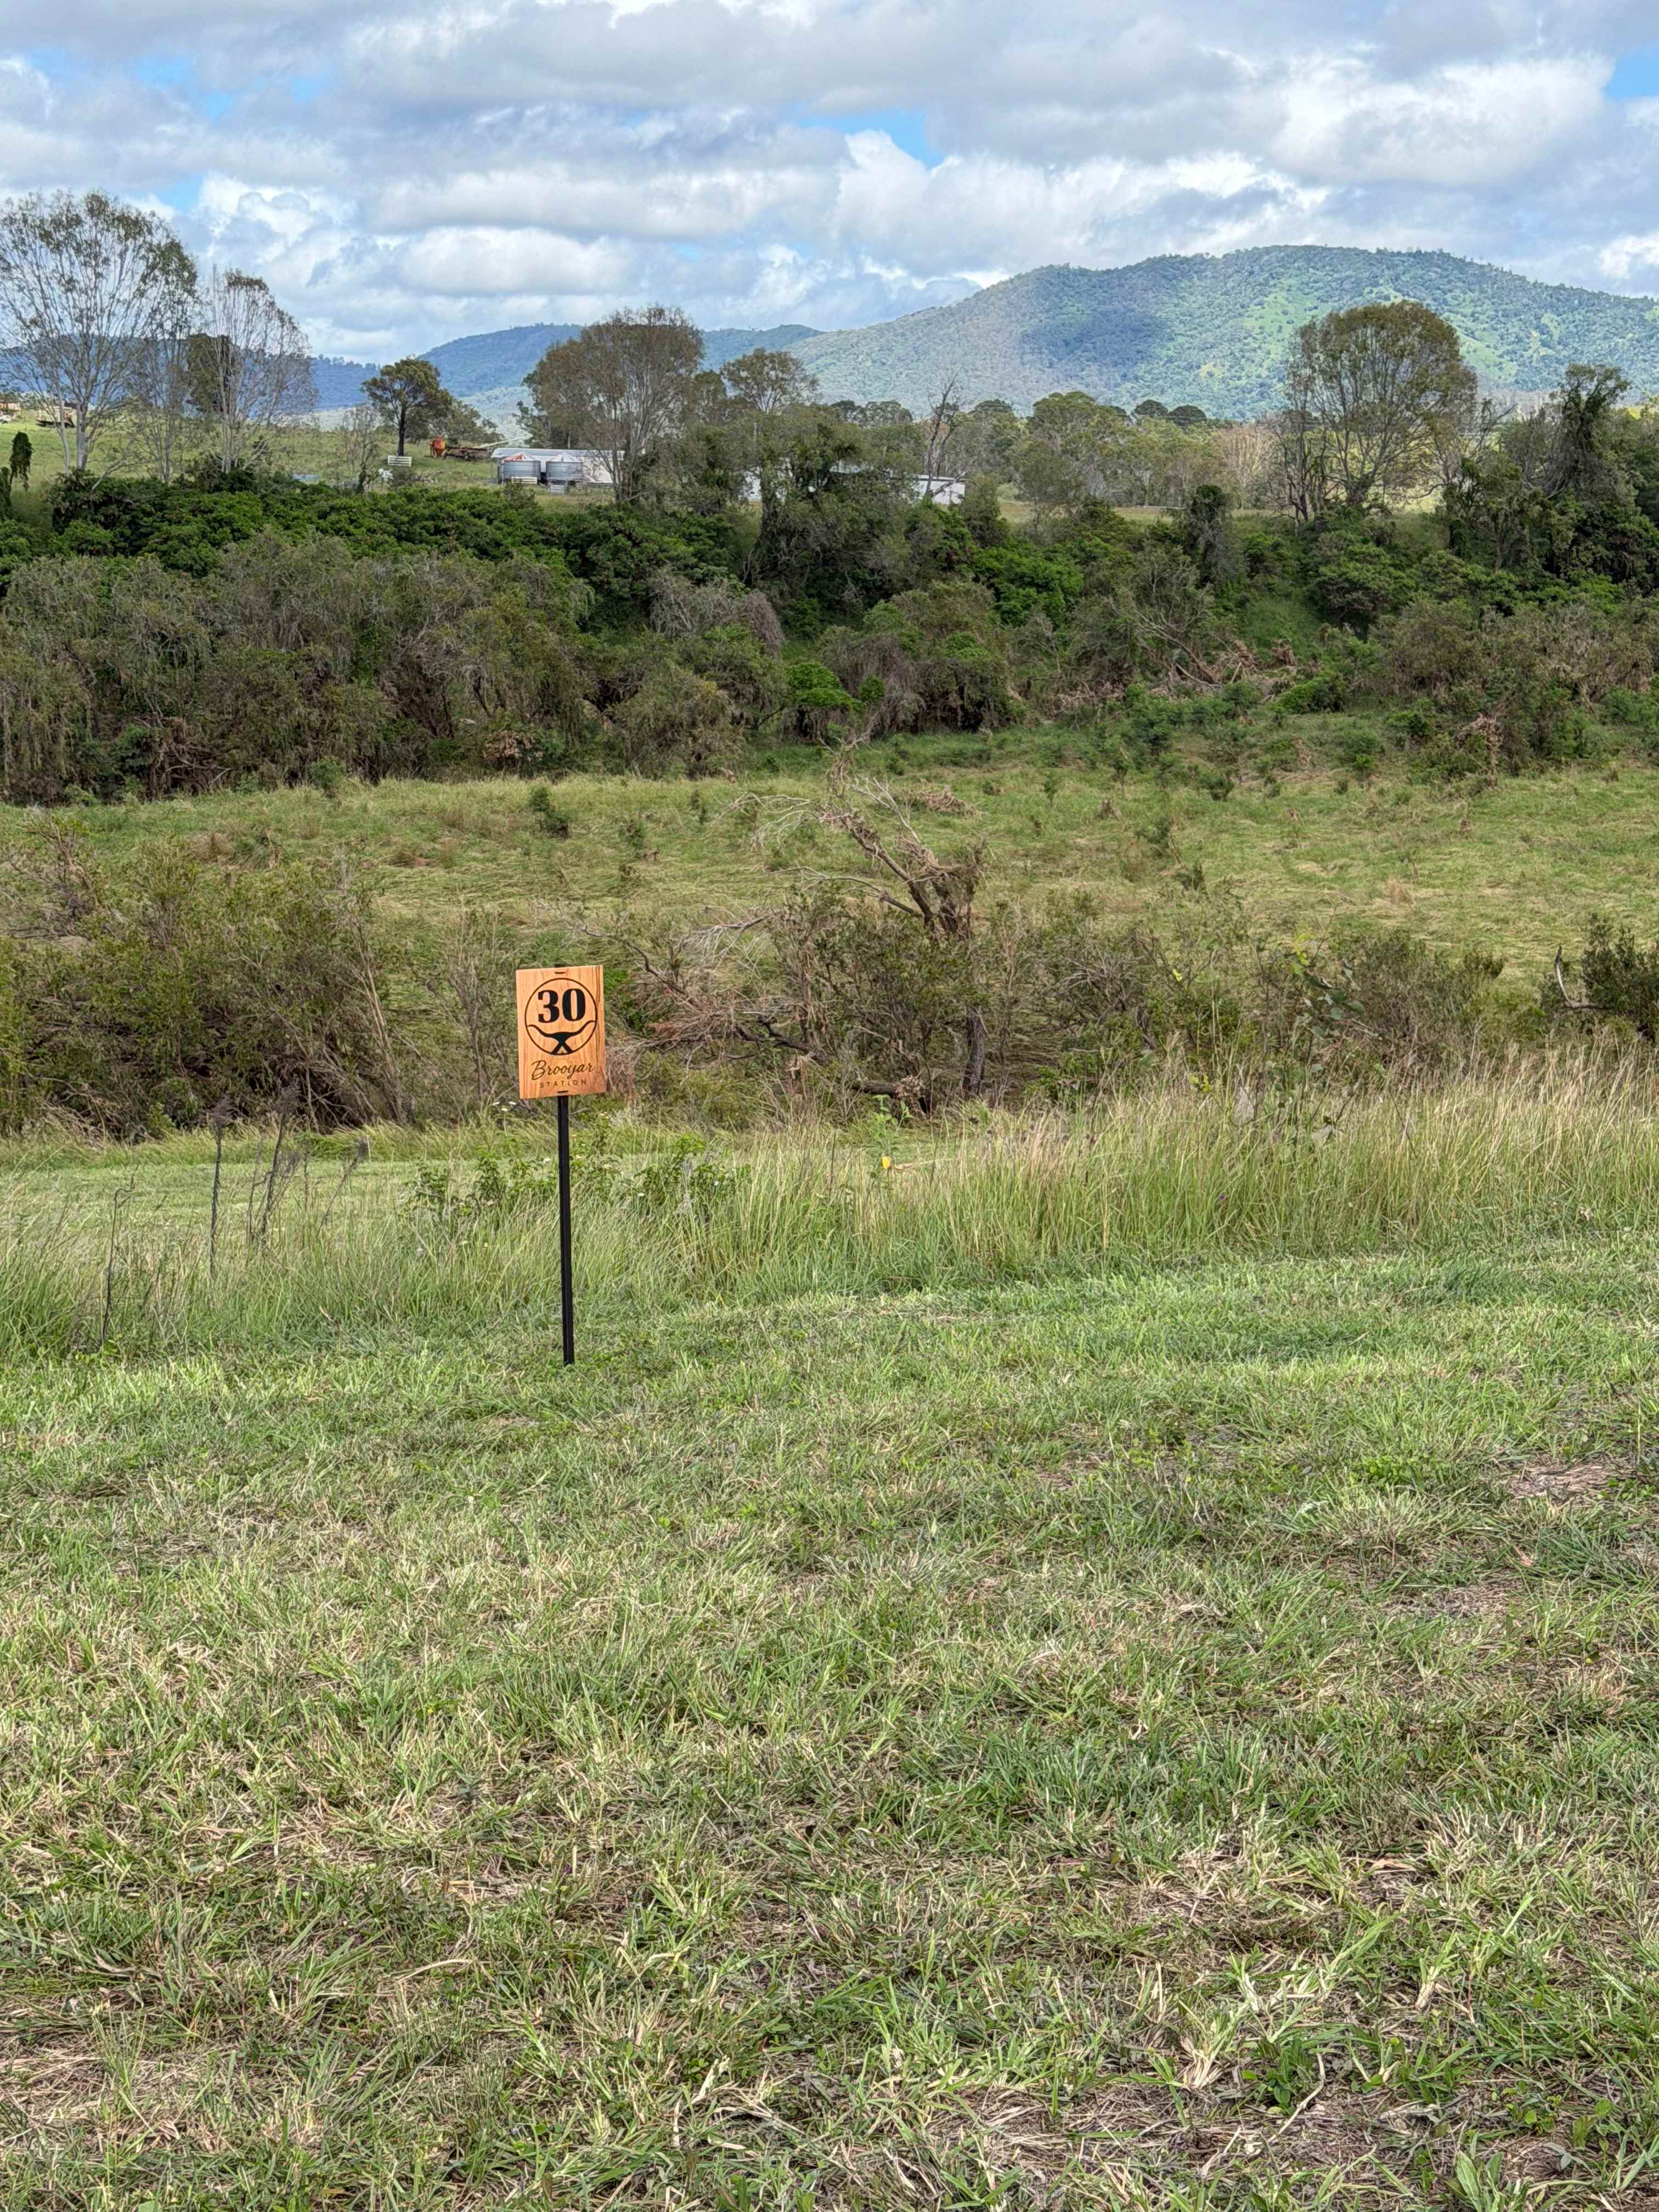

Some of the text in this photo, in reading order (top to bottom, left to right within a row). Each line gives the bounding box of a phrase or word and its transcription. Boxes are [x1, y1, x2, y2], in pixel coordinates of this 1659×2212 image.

[538, 988, 586, 1023] 30
[531, 1059, 595, 1080] Brooyar
[539, 1080, 587, 1088] STATION
